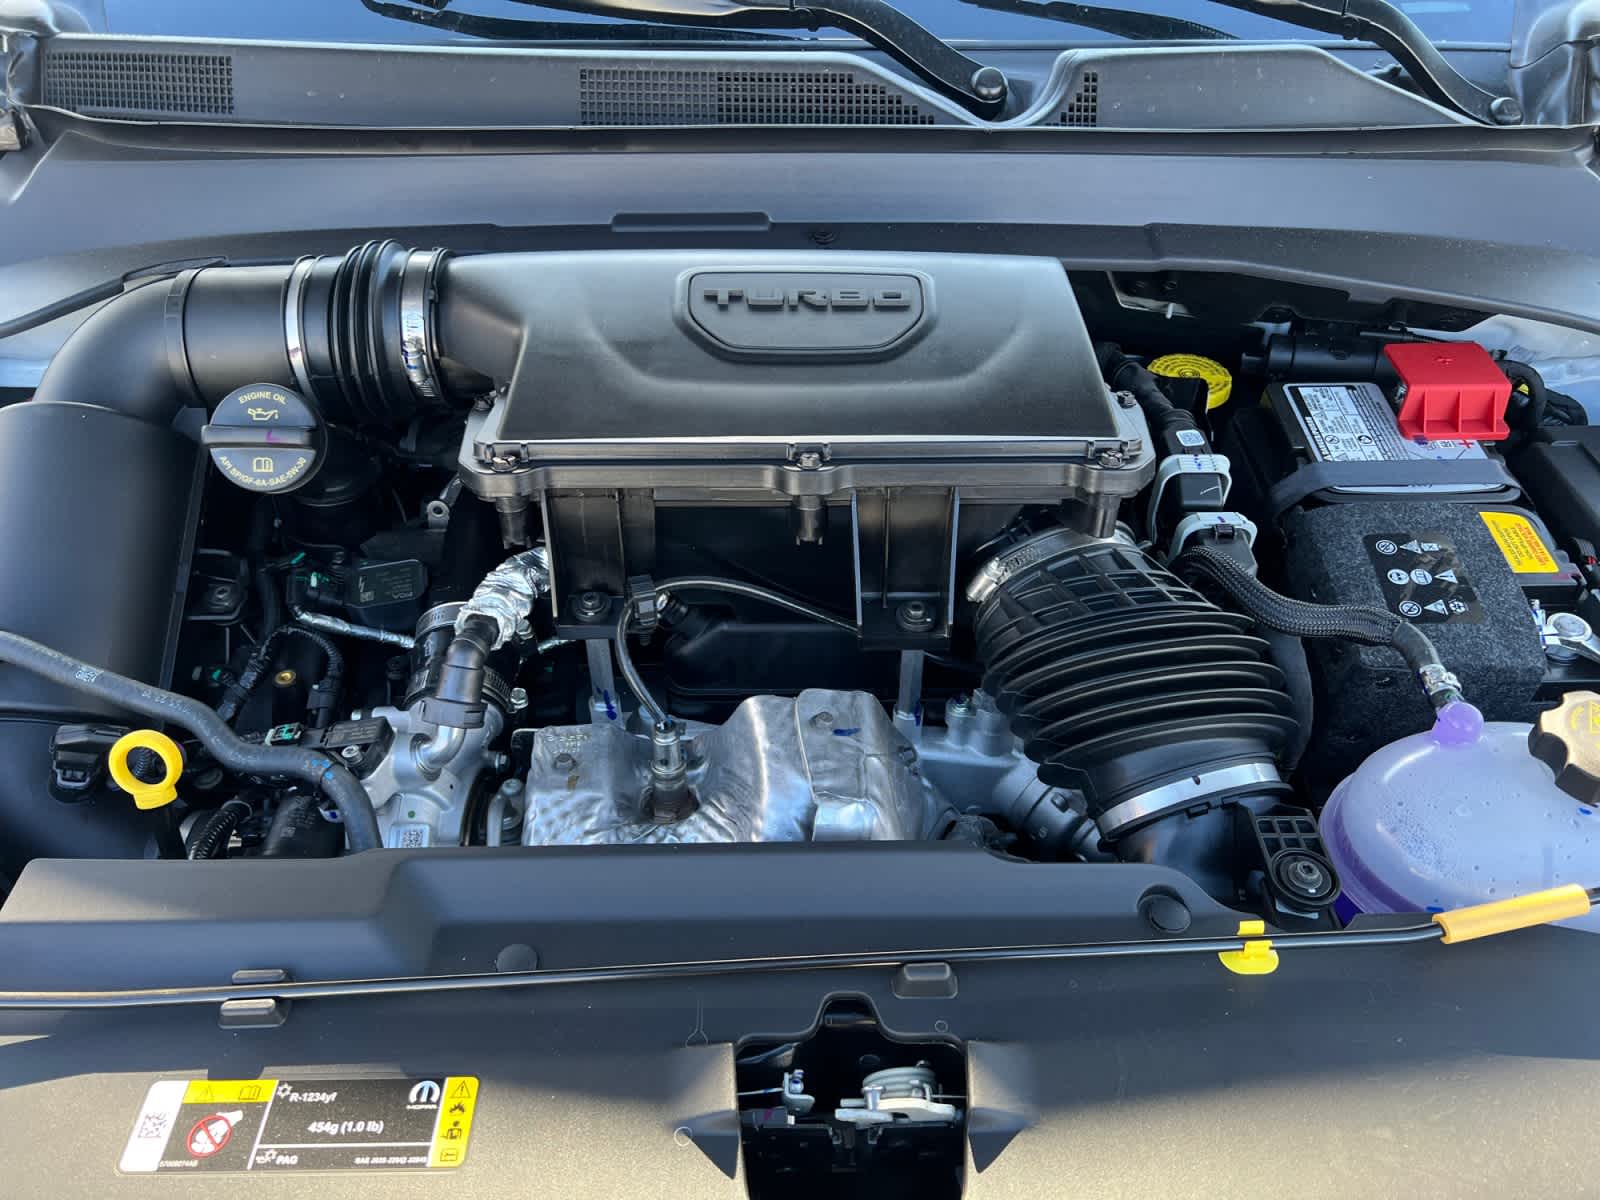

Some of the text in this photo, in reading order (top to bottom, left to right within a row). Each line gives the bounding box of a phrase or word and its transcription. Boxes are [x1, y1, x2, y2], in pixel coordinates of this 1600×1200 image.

[704, 288, 912, 311] TURBO
[238, 391, 287, 405] ENGINE OIL
[289, 1092, 337, 1103] R-1234yf
[307, 1120, 384, 1135] 454g (1.0 lb)
[276, 1154, 299, 1165] PAG
